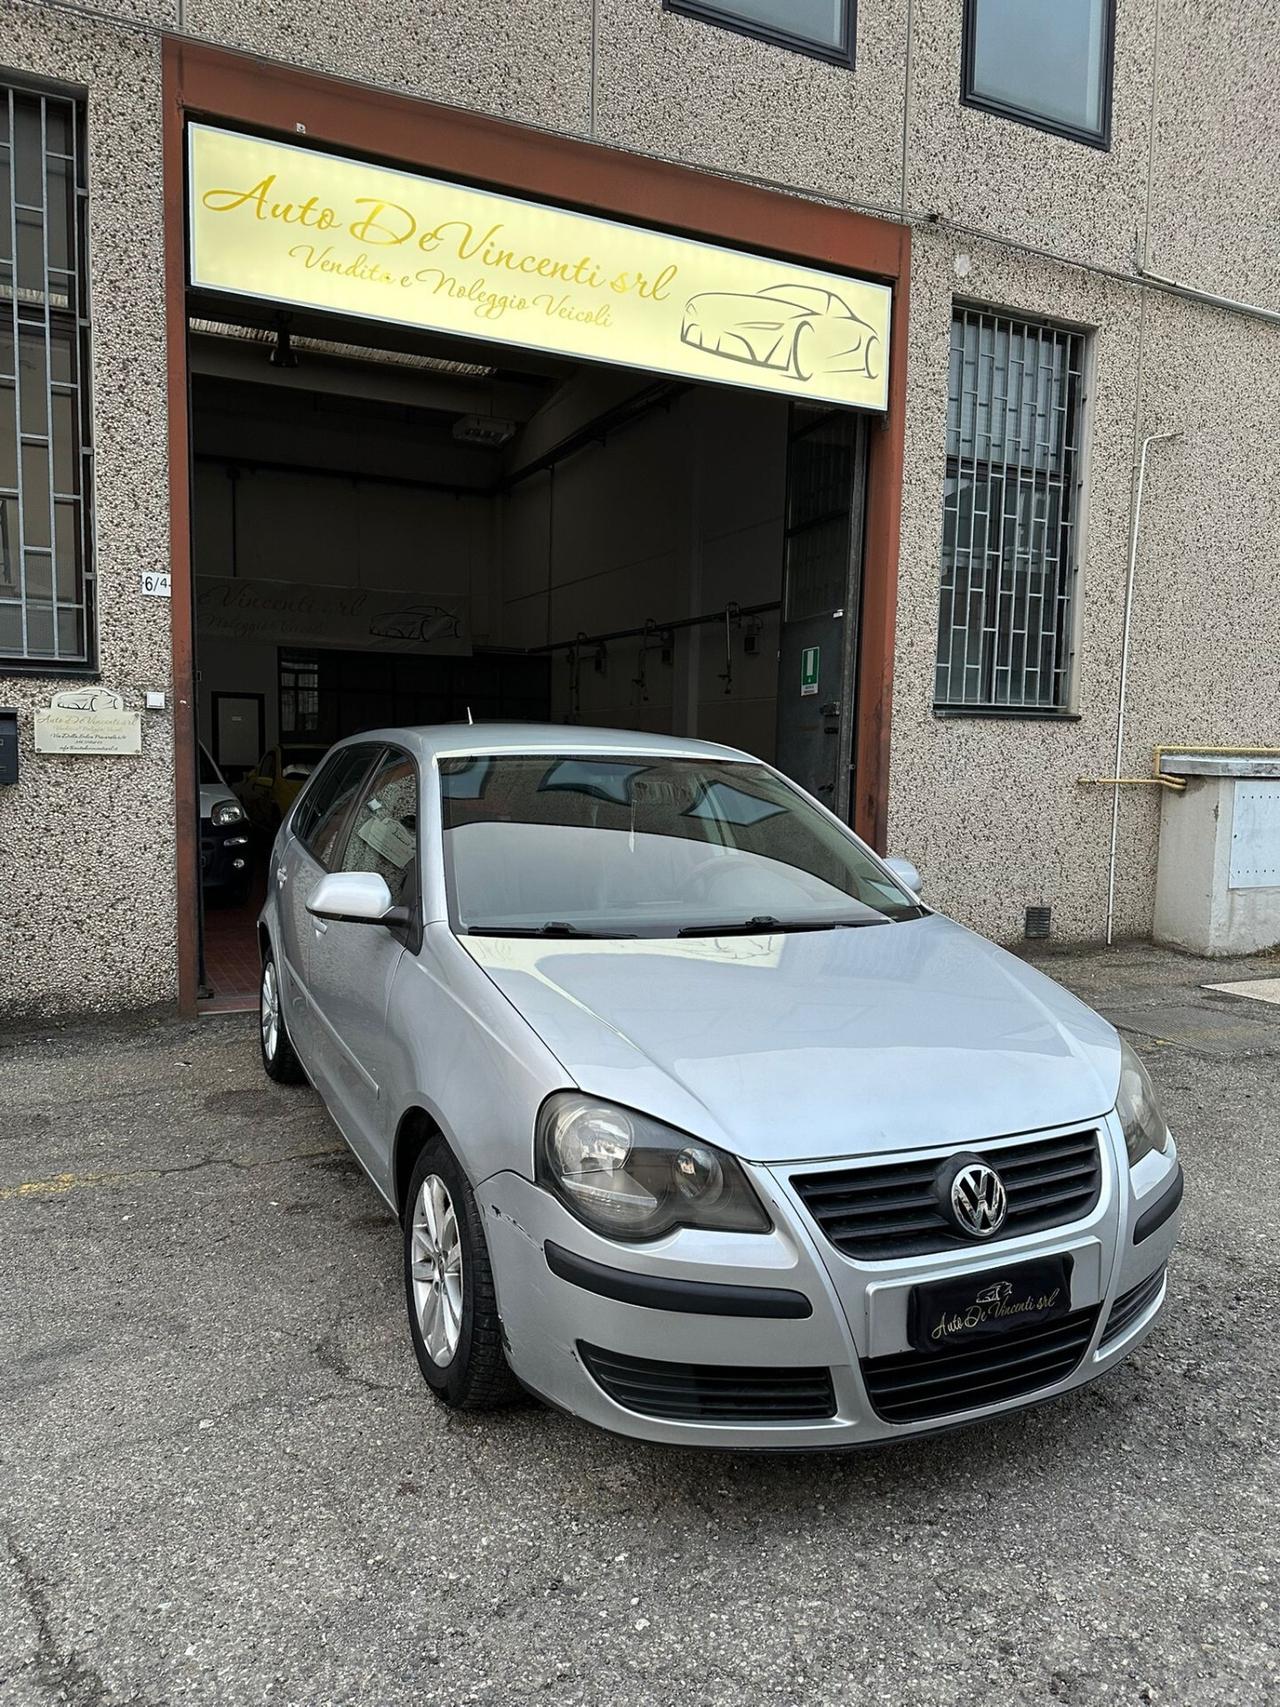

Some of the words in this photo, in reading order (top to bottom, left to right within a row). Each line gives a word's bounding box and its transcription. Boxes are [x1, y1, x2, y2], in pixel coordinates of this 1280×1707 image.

[203, 174, 342, 231] Auto
[610, 264, 678, 301] srl
[400, 274, 412, 289] e
[416, 268, 529, 320] Noleggio
[532, 294, 613, 328] Veicoli
[144, 575, 168, 592] 6/4
[931, 1312, 964, 1339] Auto
[1036, 1288, 1060, 1310] srl
